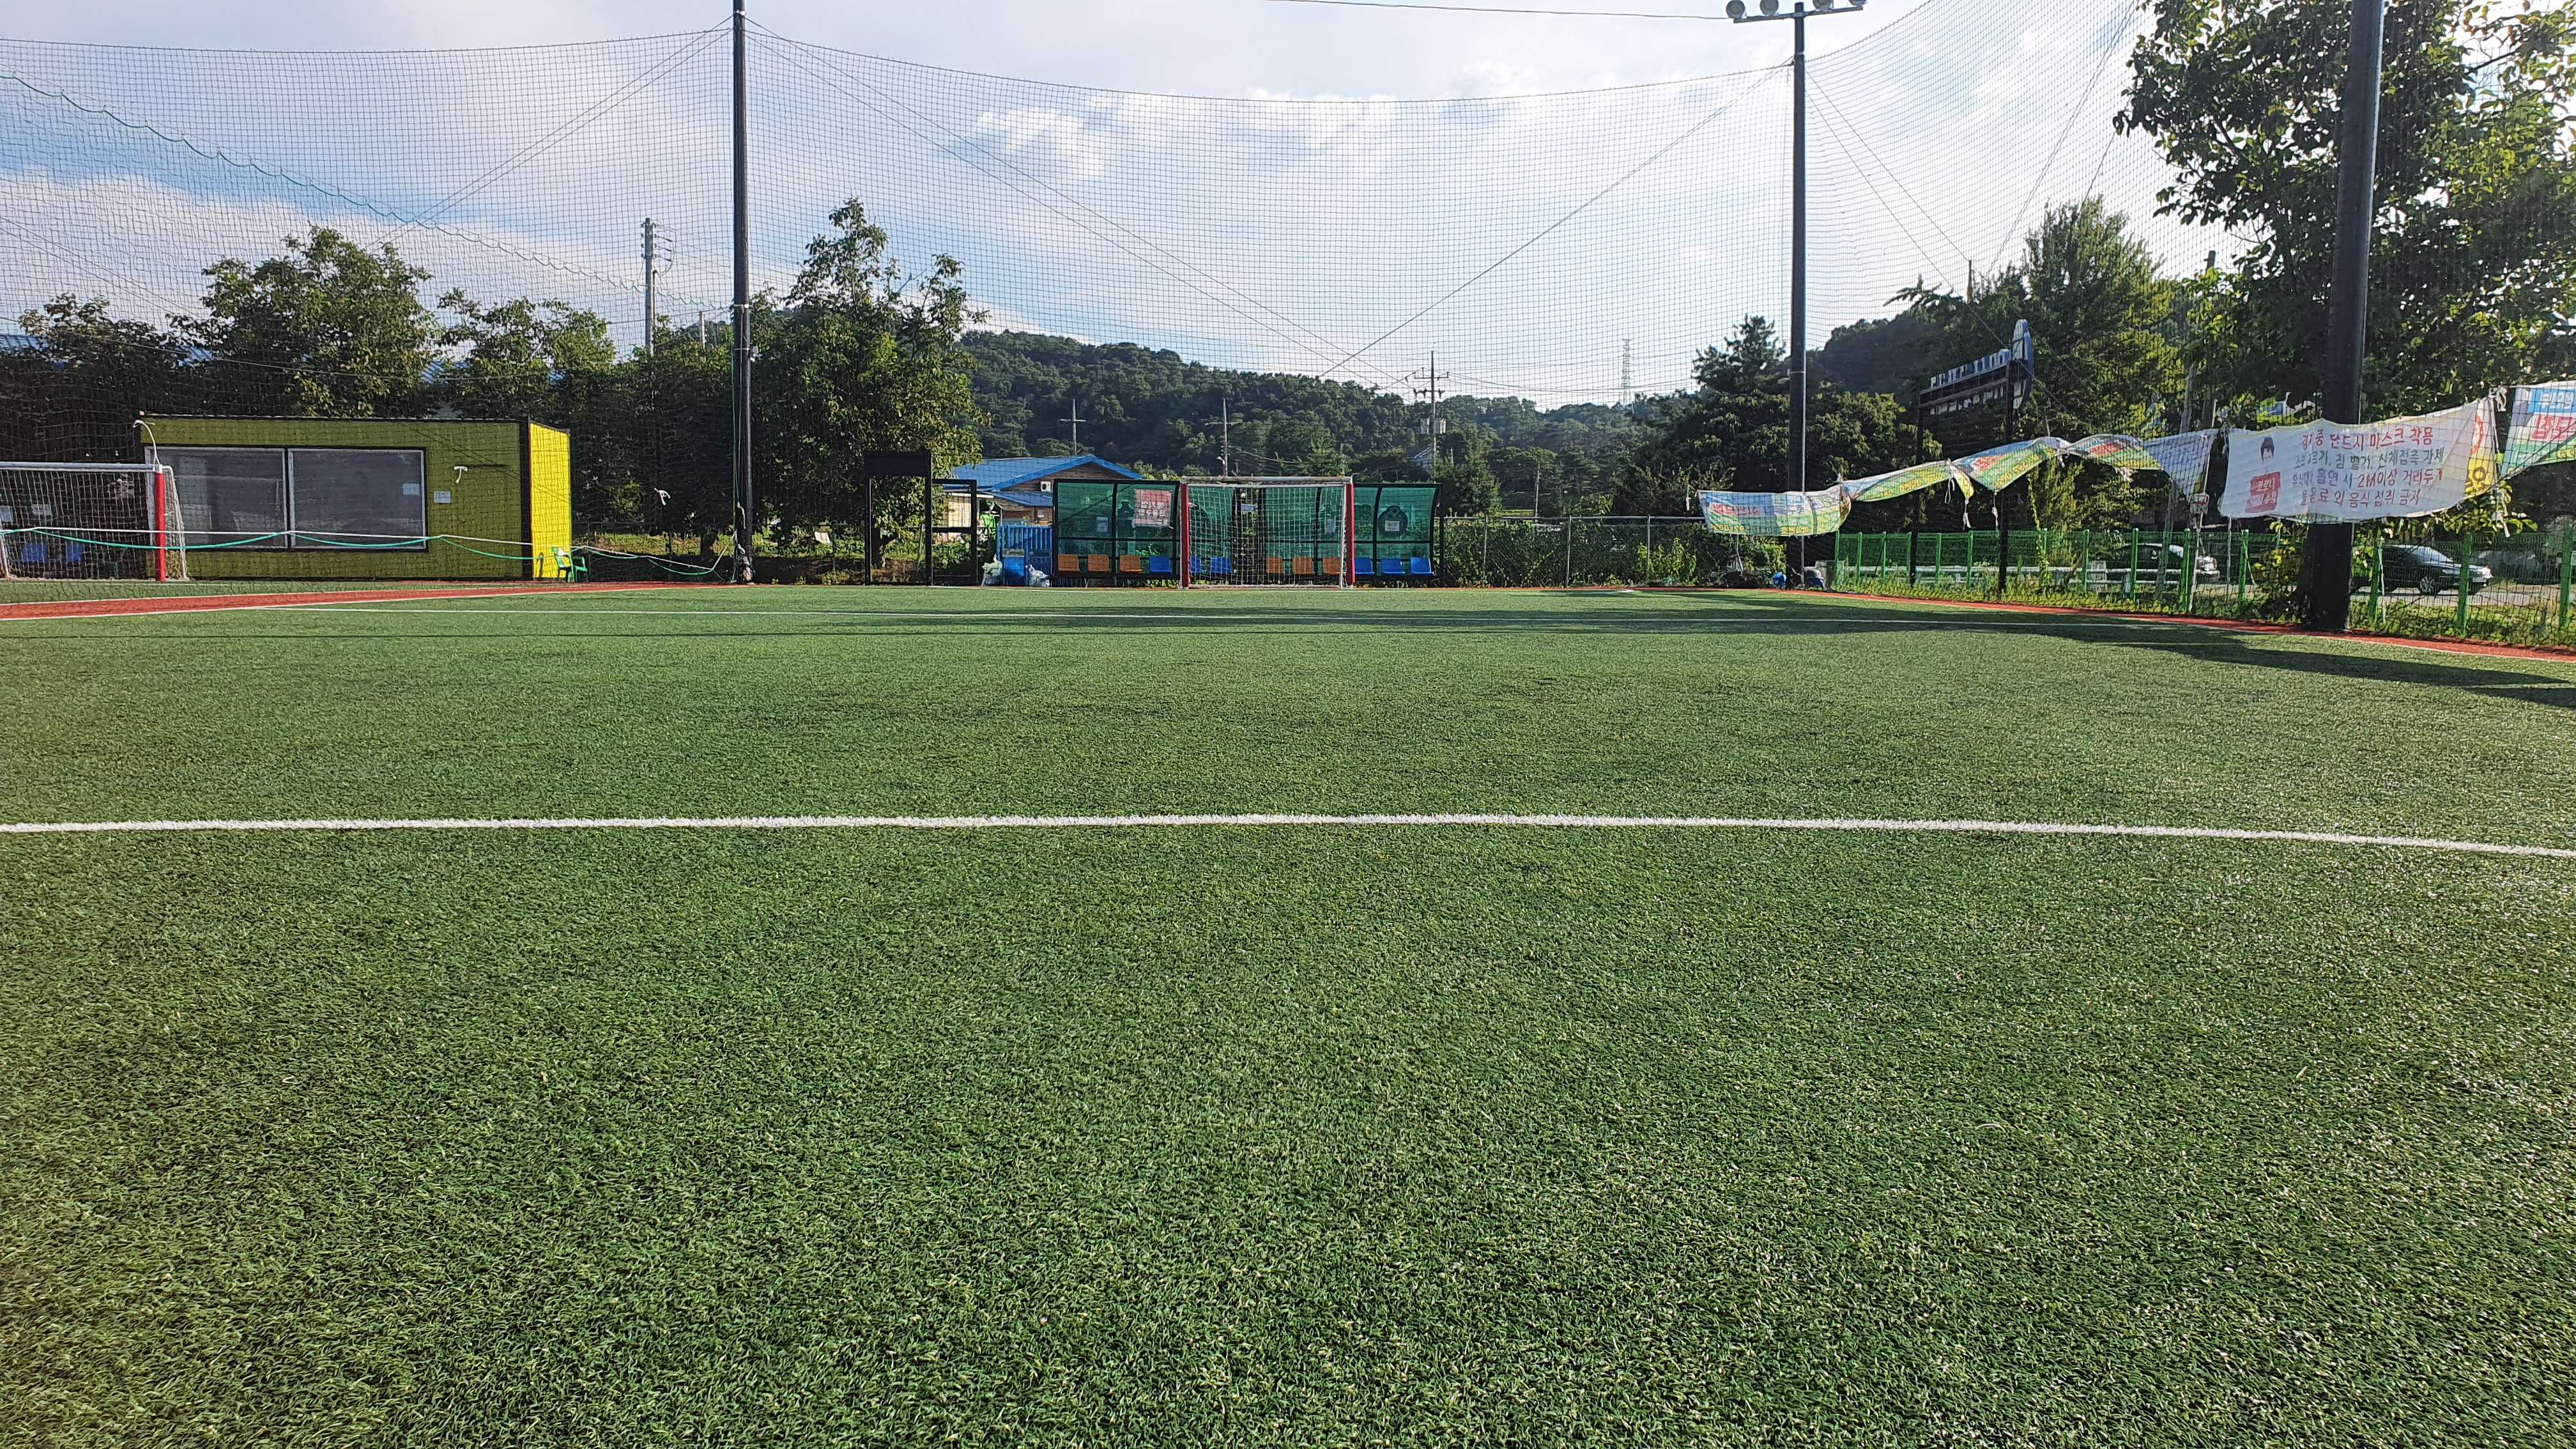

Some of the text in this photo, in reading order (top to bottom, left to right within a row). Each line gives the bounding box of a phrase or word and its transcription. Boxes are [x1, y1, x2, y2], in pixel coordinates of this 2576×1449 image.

[2330, 434, 2364, 451] 반드시
[2370, 428, 2405, 448] 마스크
[2409, 427, 2434, 445] 착용
[2335, 454, 2345, 469] 침
[2378, 449, 2420, 469] 신체접촉
[2423, 447, 2444, 465] 자제
[2317, 468, 2338, 486] 흡연
[2344, 473, 2352, 489] 시
[2358, 470, 2398, 488] 2M이상
[2334, 490, 2345, 507] 외
[2349, 491, 2370, 508] 음식
[2374, 489, 2395, 507] 섭취
[2399, 488, 2420, 505] 금지
